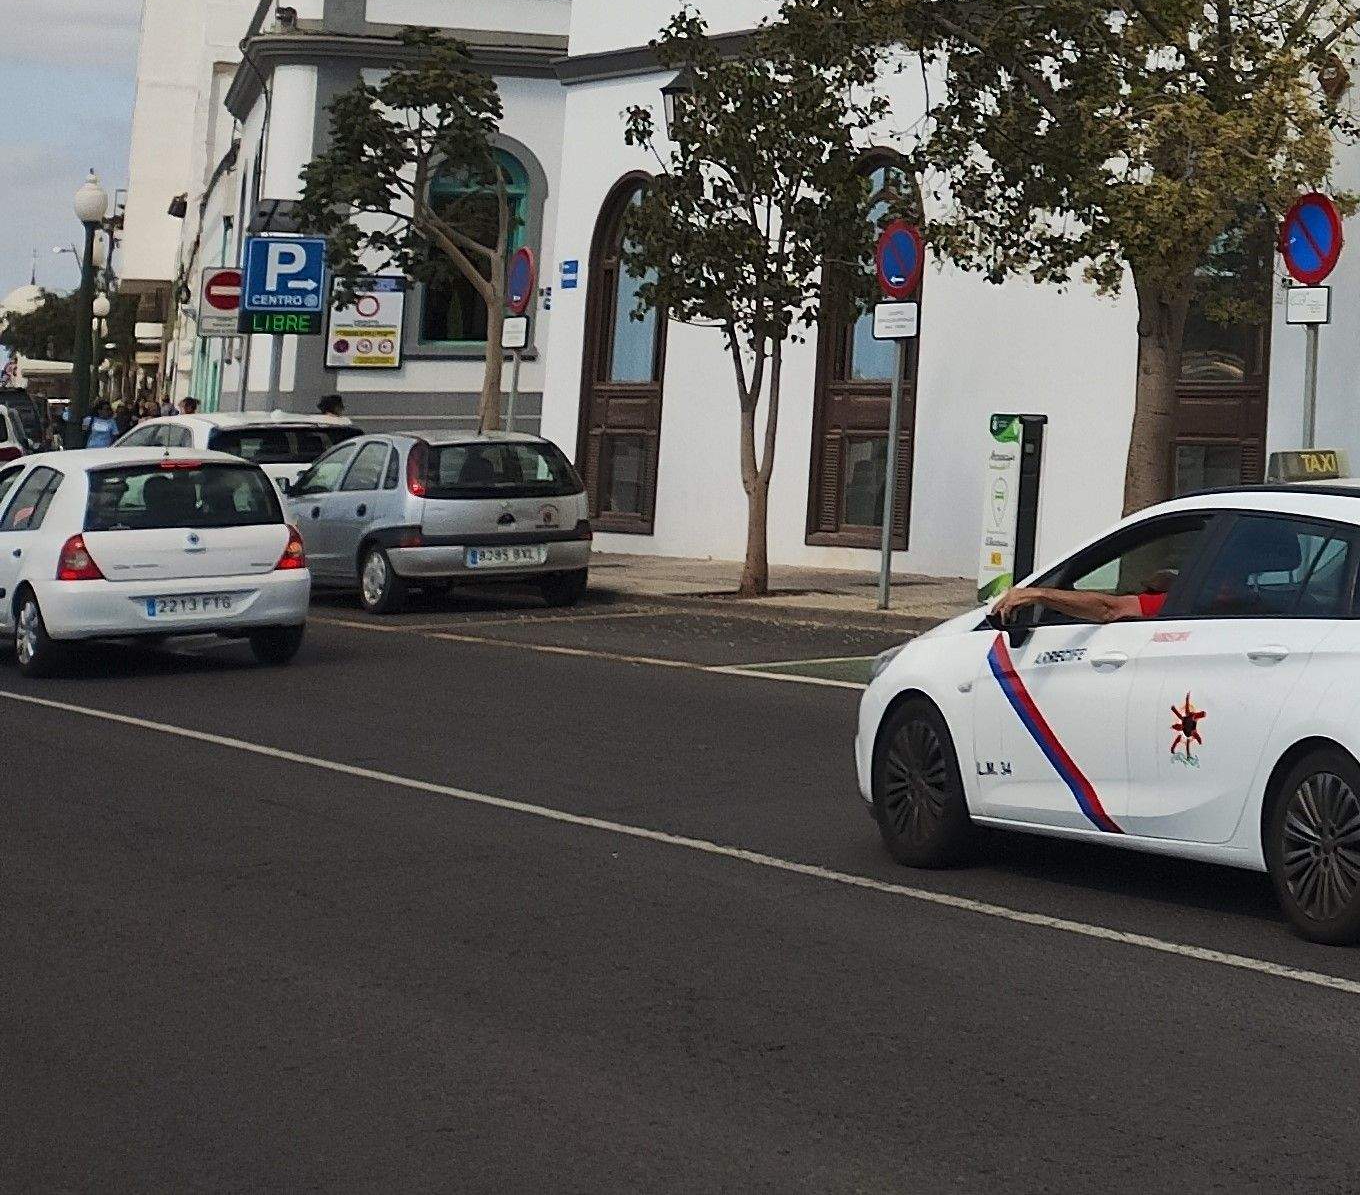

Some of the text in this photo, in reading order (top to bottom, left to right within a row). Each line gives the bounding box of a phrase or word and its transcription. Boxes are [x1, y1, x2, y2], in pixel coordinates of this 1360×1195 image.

[265, 242, 307, 292] P
[252, 294, 302, 307] CENTRO
[252, 314, 311, 332] LIBRE
[1300, 453, 1337, 473] TAXI
